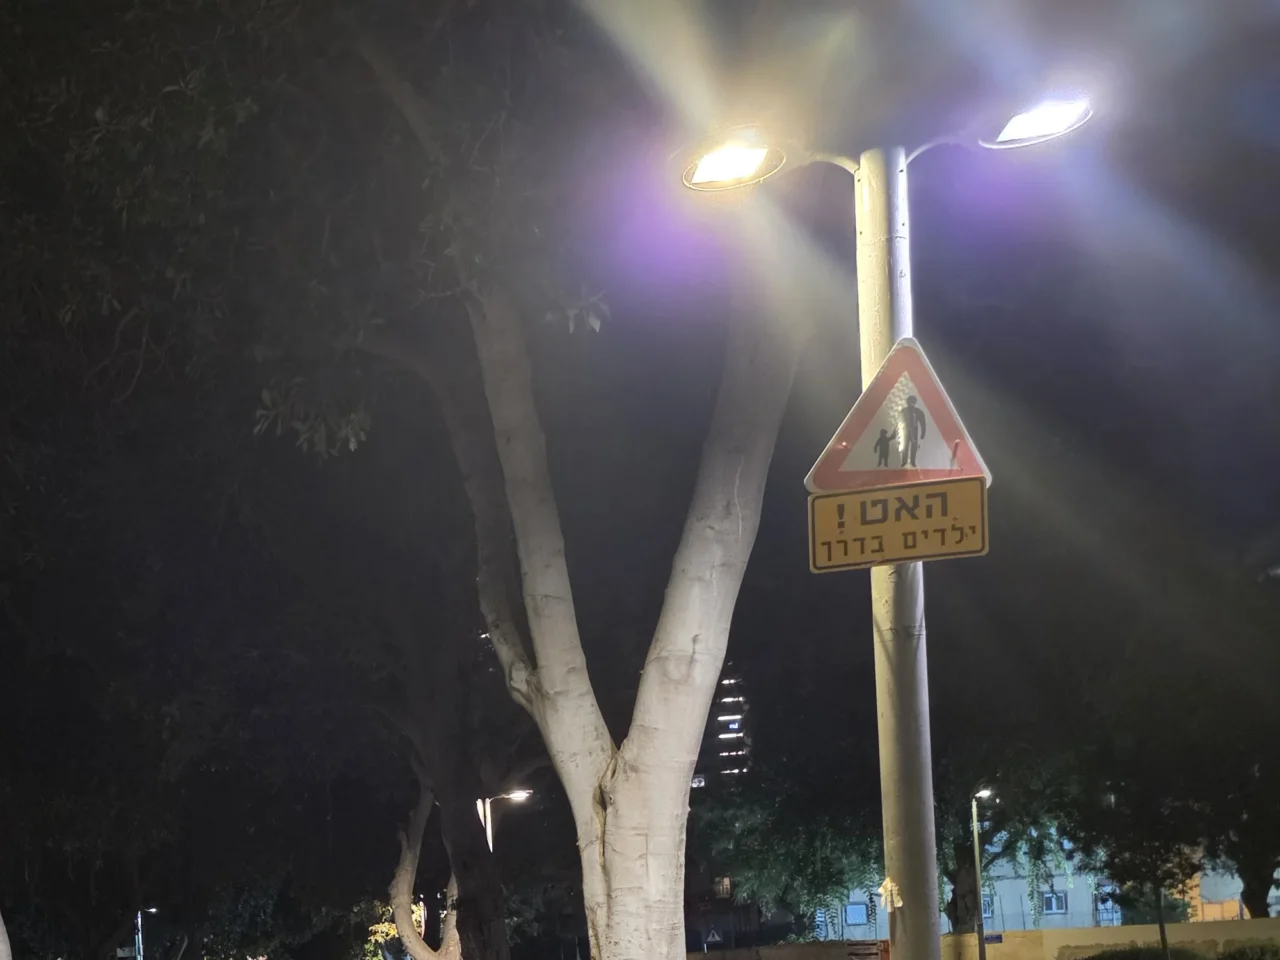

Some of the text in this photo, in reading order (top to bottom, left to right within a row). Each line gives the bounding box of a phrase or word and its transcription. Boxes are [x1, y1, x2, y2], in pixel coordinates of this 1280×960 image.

[860, 491, 948, 526] האט
[821, 523, 977, 562] ילדים בדרך
